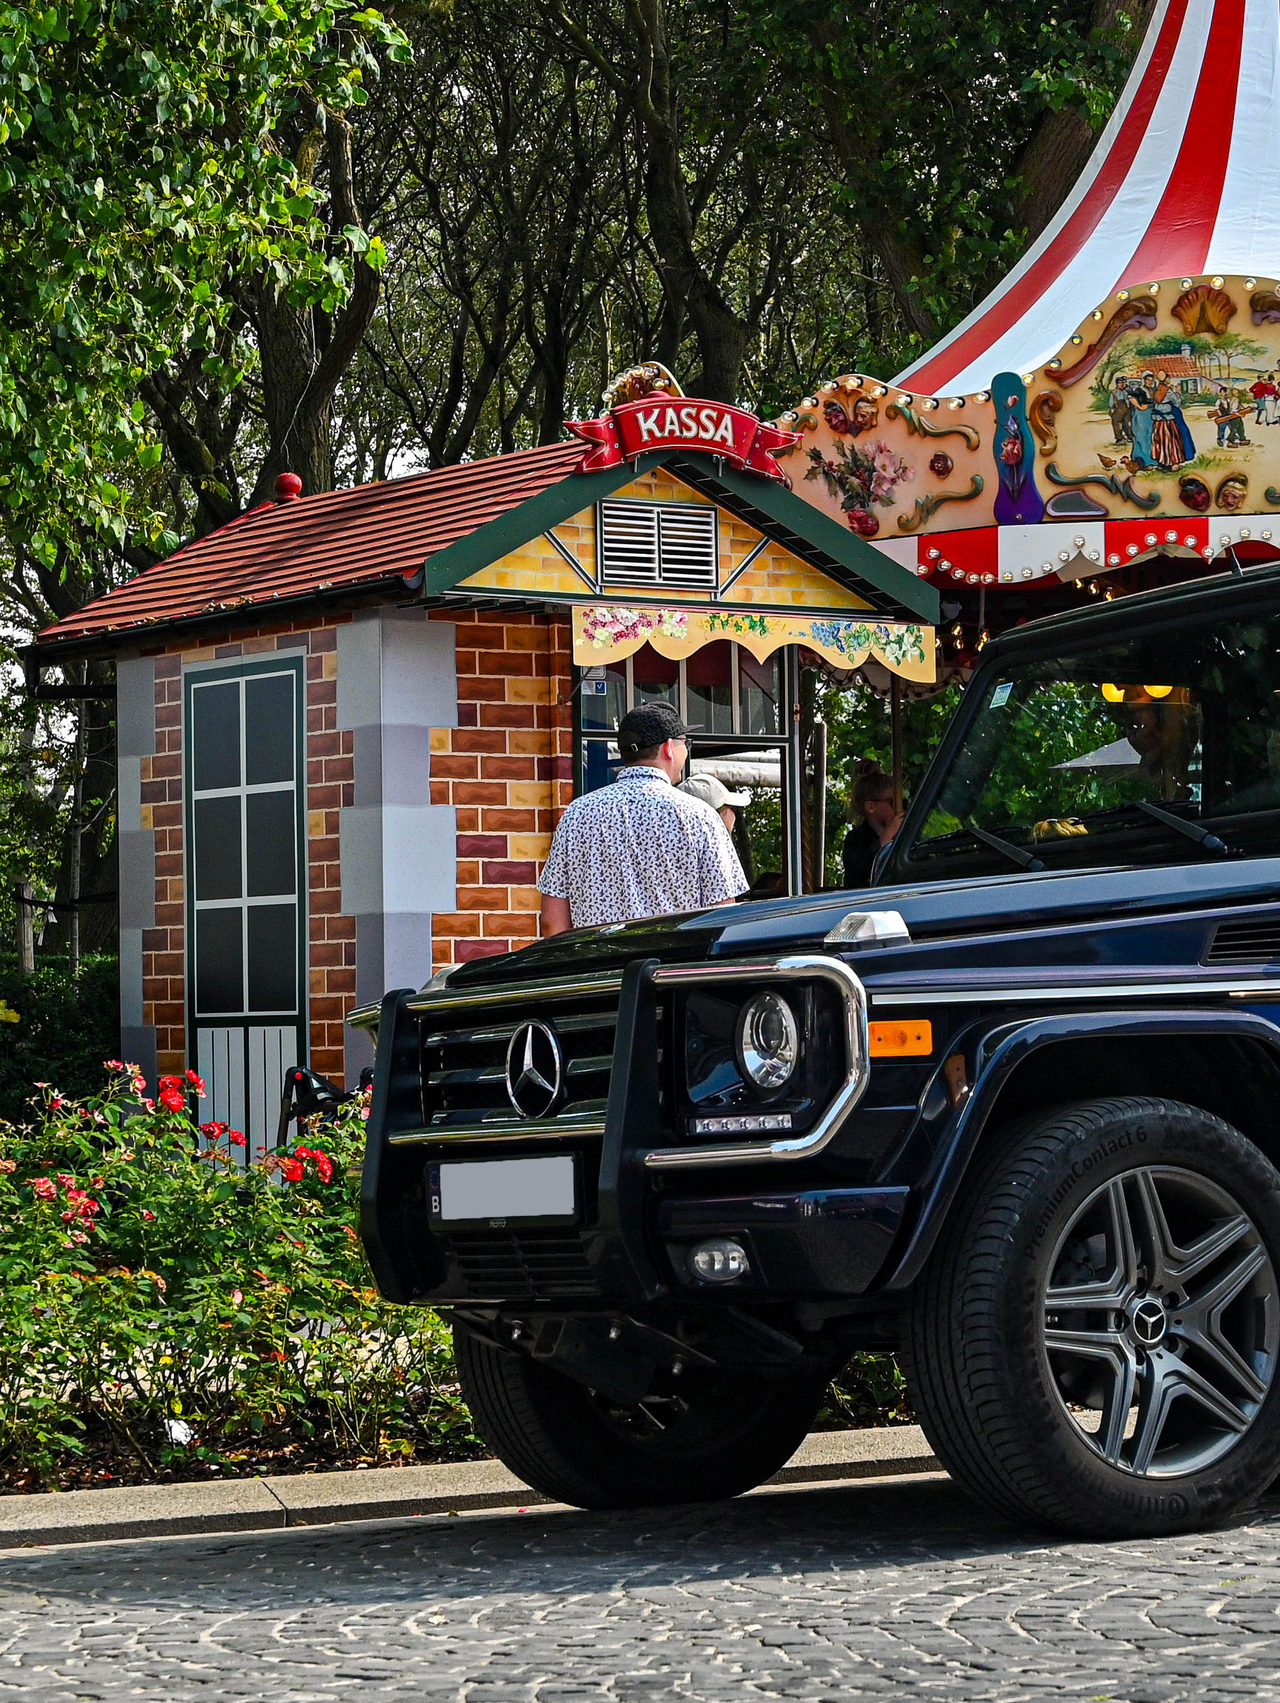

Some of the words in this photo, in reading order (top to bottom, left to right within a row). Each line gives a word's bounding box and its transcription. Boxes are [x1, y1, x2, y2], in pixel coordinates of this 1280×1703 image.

[636, 407, 735, 447] KASSA
[431, 1195, 441, 1213] B
[1022, 1129, 1134, 1261] PremiumContact
[1135, 1125, 1148, 1143] 6
